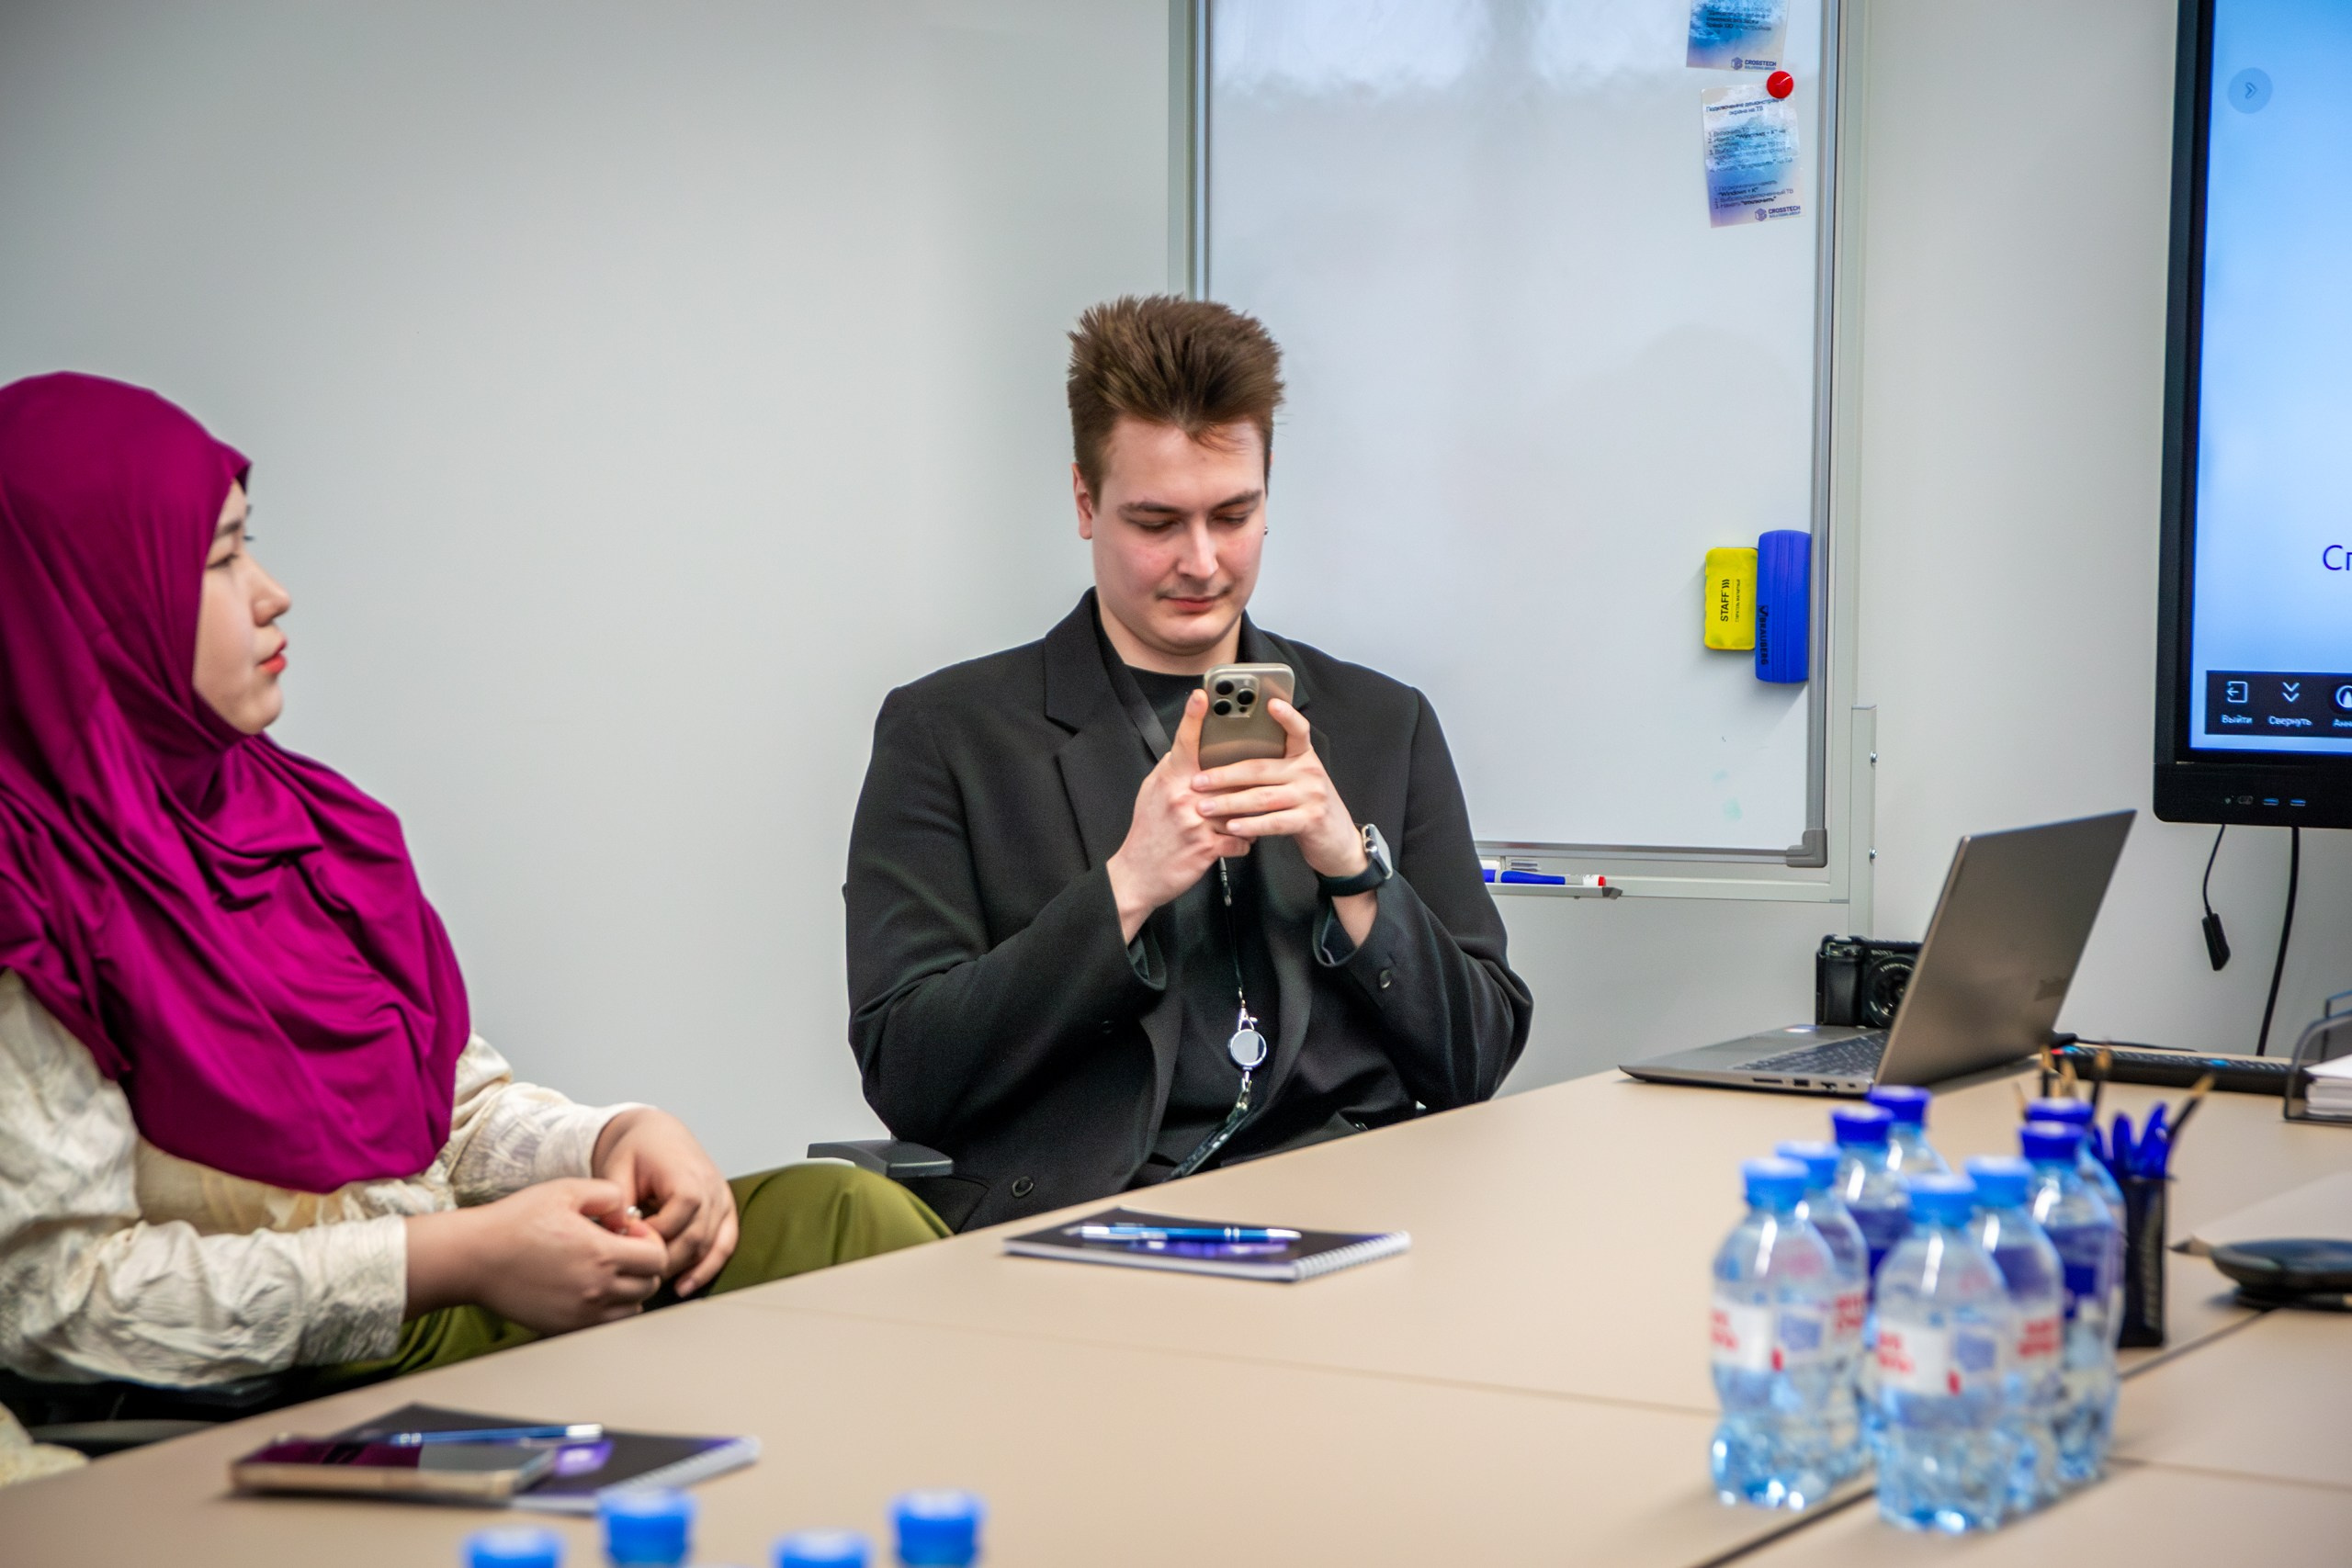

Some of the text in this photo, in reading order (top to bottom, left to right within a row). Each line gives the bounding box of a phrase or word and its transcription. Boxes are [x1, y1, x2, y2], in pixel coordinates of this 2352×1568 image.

[1745, 59, 1777, 67] CROSSTECH
[1706, 103, 1744, 112] Подключение
[1729, 107, 1748, 116] экрана
[1769, 205, 1801, 214] CROSSTECH
[1720, 591, 1729, 622] STAFF
[1758, 616, 1770, 665] BRAUBERG
[2222, 714, 2253, 725] Выйти
[2267, 715, 2312, 727] Свернуть
